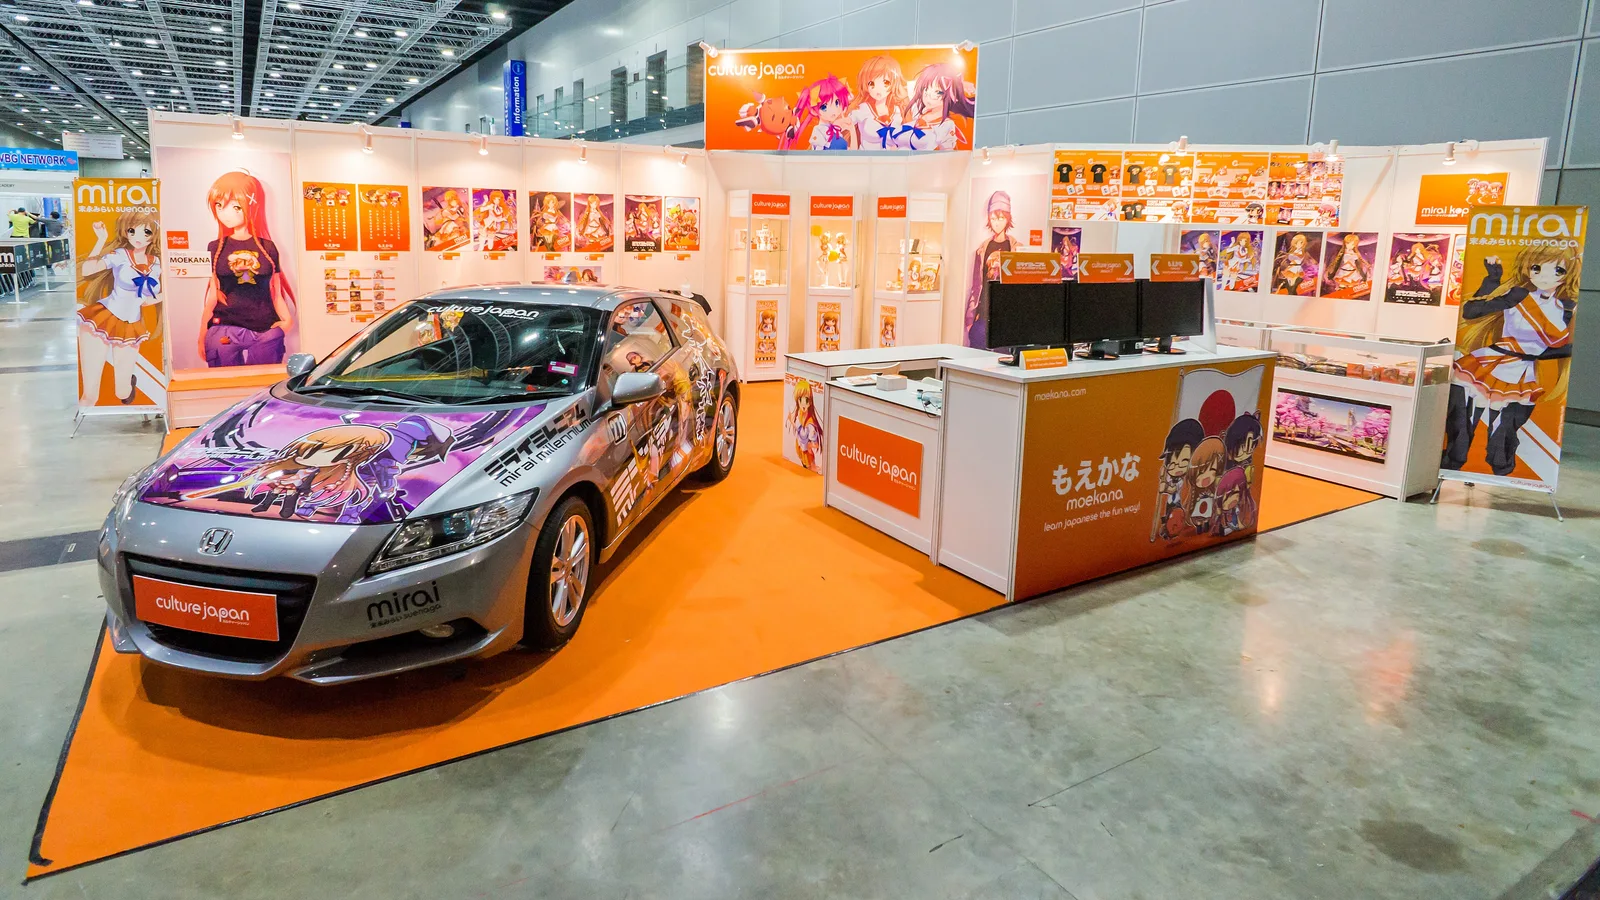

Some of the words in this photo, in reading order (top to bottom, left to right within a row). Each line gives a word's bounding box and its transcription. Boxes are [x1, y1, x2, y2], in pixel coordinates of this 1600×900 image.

[708, 62, 758, 76] culture
[758, 62, 804, 80] japan
[20, 154, 66, 165] NETWORK
[78, 180, 158, 204] mirai
[116, 206, 158, 216] suenaga
[1421, 206, 1448, 214] mirai
[1470, 208, 1583, 237] mirai
[1518, 238, 1579, 250] suenaga
[427, 304, 484, 313] culture
[478, 305, 540, 318] japan
[1034, 388, 1086, 401] moekana.com
[500, 456, 538, 488] mirai
[536, 418, 592, 460] millennium
[840, 444, 878, 468] culture
[877, 456, 917, 486] japan
[1052, 452, 1141, 495] もえかな
[1066, 489, 1124, 511] moekana
[1044, 520, 1062, 532] learn
[1064, 512, 1098, 530] japanese
[1100, 508, 1110, 518] the
[1112, 506, 1123, 516] fun
[1124, 501, 1141, 516] way!
[156, 595, 201, 614] culture
[202, 602, 249, 622] japan
[367, 580, 440, 621] mirai
[404, 604, 442, 618] suenaga
